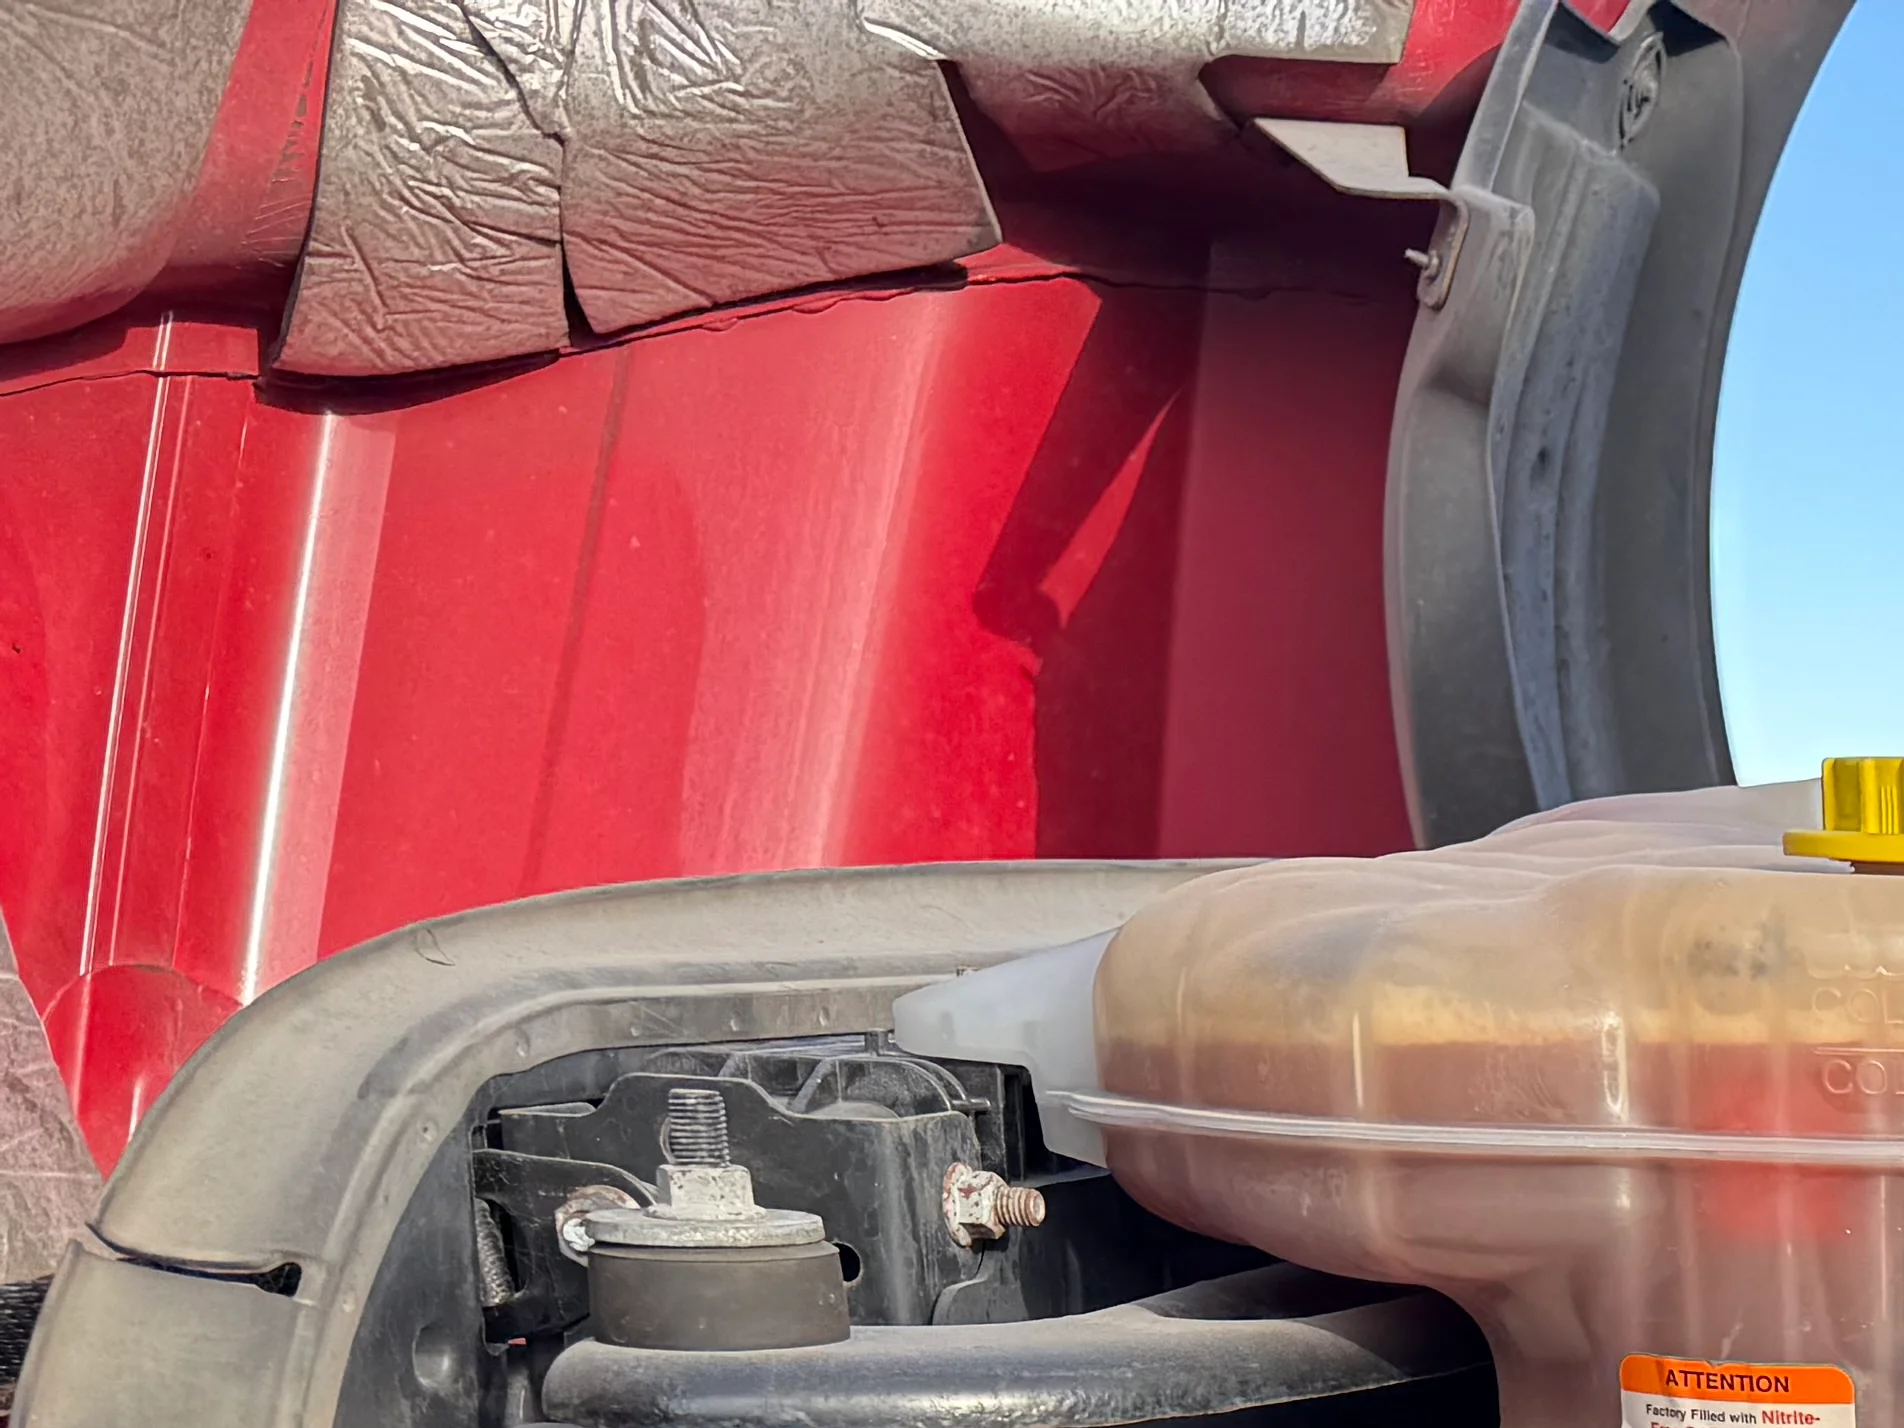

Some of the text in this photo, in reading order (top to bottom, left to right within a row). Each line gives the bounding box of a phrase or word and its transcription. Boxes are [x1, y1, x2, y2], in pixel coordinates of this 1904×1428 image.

[1665, 1369, 1790, 1393] ATTENTION
[1646, 1404, 1821, 1426] Factory Filled with Nitrite-
